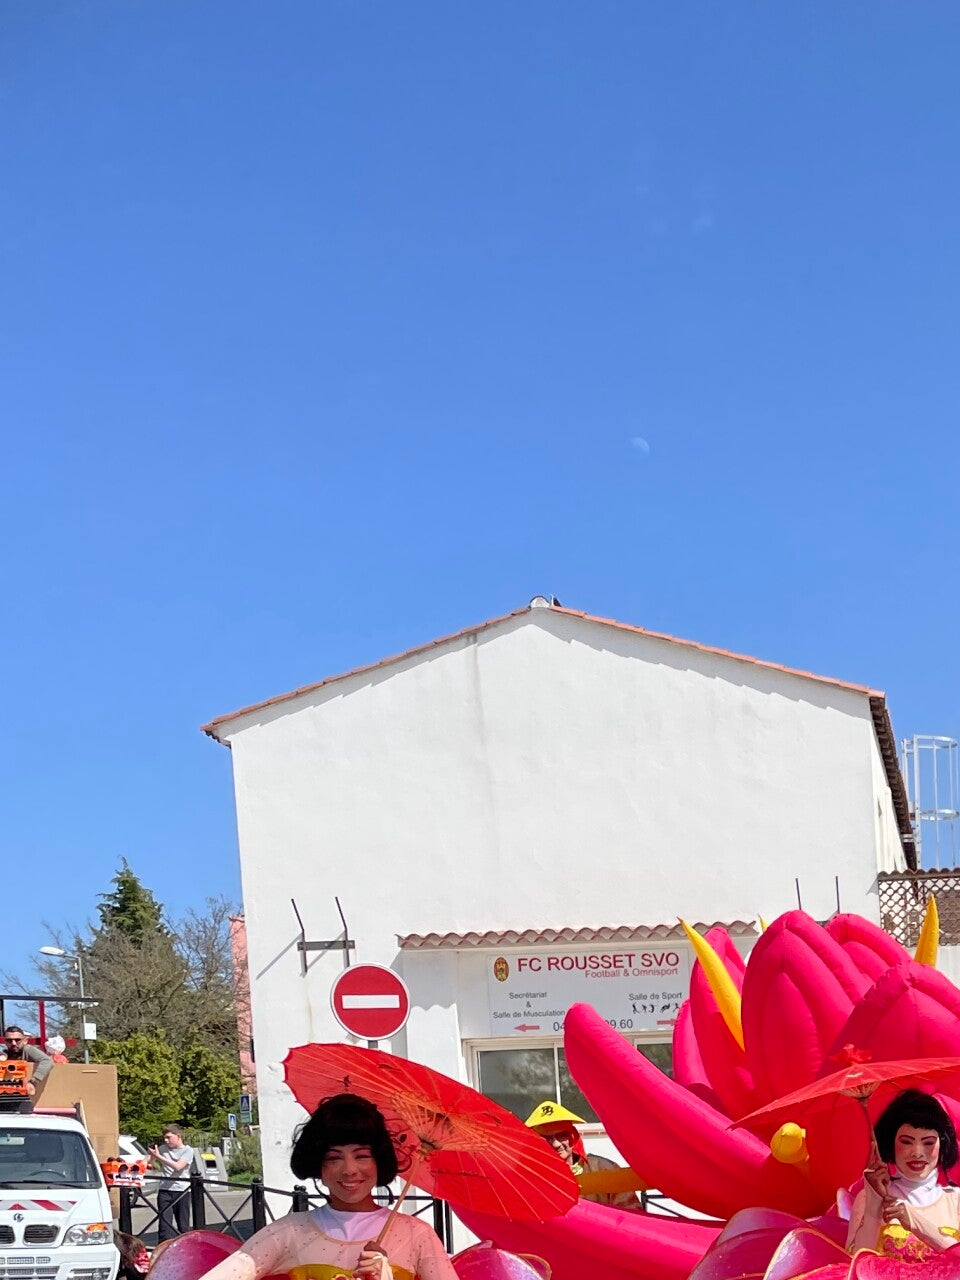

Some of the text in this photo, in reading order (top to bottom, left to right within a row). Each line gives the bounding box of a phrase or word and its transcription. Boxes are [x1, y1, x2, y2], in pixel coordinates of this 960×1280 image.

[517, 952, 679, 972] FC ROUSSET SVO
[585, 967, 678, 978] Football & Omnisport
[629, 992, 682, 1001] Salle de Sport
[493, 1011, 511, 1019] Salle
[524, 1009, 565, 1018] Musculation
